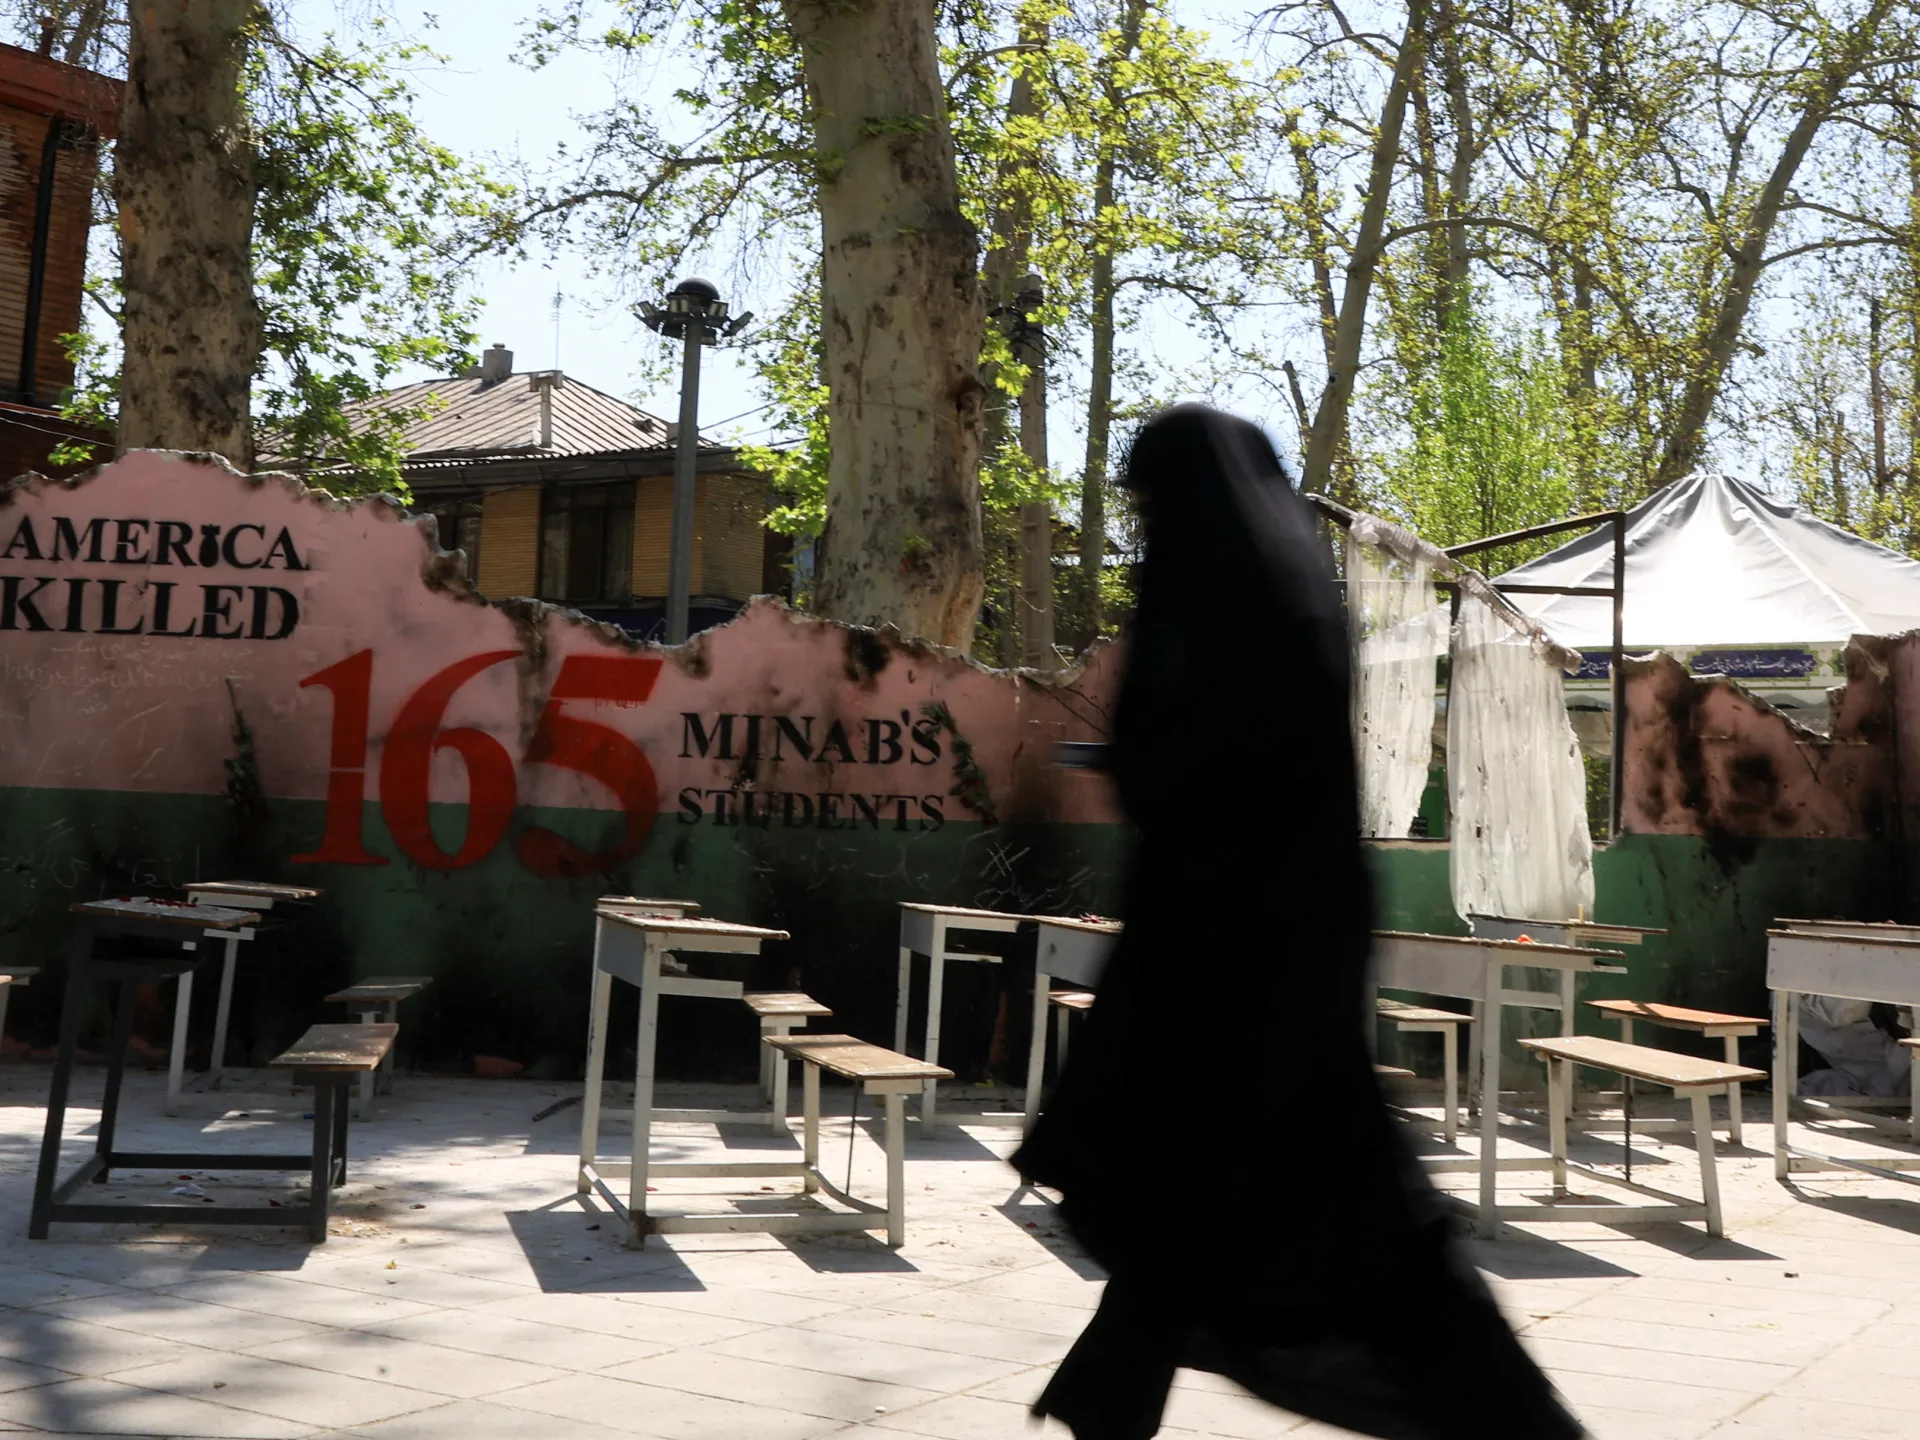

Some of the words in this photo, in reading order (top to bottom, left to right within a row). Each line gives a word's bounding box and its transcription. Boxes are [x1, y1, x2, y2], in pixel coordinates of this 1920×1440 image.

[0, 513, 310, 571] AMERICA
[0, 577, 300, 641] KILLED
[290, 648, 665, 879] 165
[678, 709, 941, 766] MINAB'S
[678, 787, 945, 832] STUDENTS
